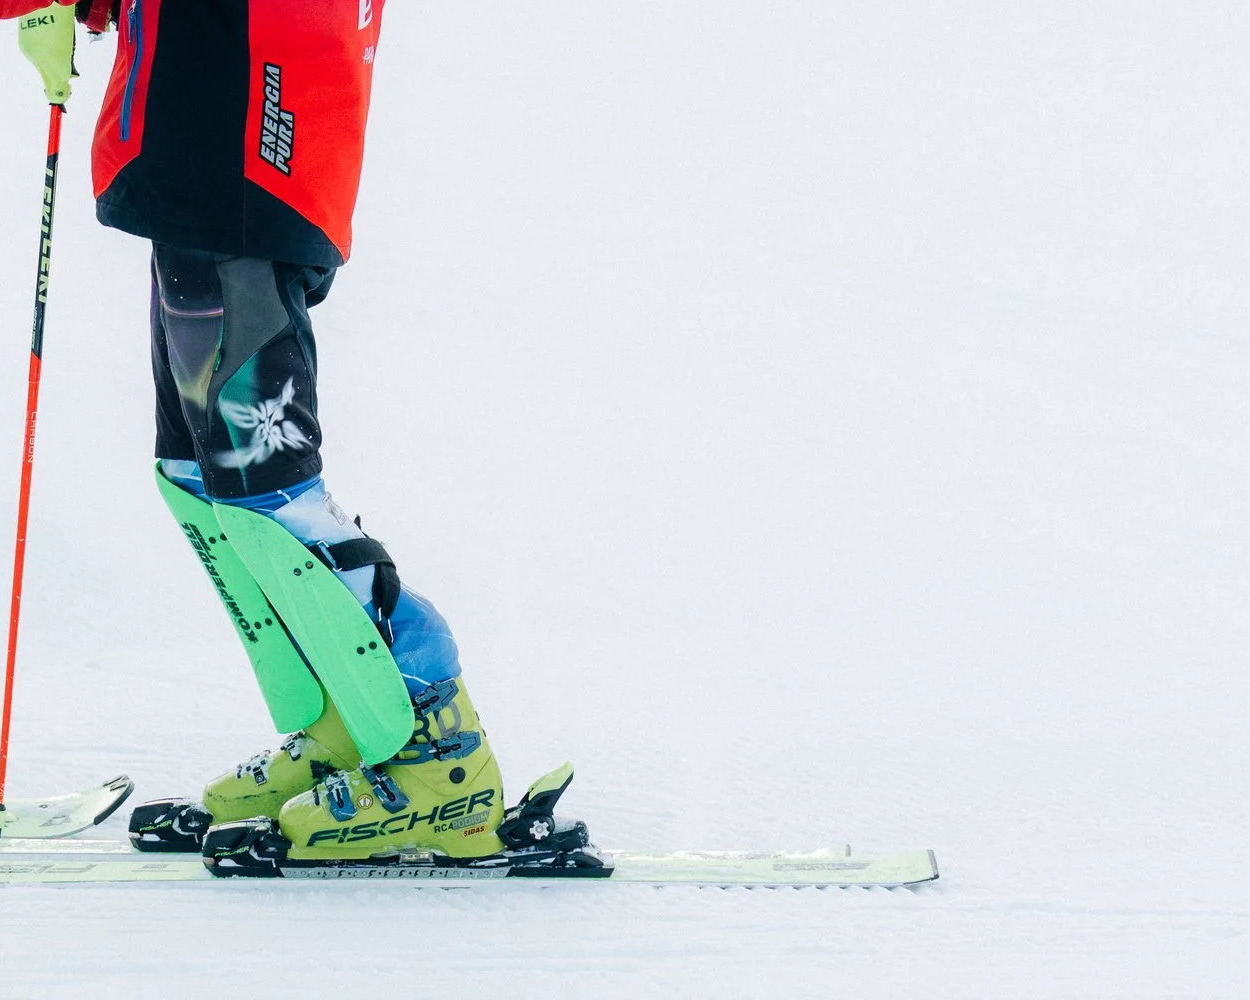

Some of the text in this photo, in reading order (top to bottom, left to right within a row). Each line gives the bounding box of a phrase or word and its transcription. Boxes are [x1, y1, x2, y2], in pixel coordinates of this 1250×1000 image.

[20, 14, 55, 30] LEKI
[260, 64, 280, 164] ENERGIA
[275, 111, 294, 175] PURA
[181, 522, 259, 644] KOMPERDELL
[139, 819, 173, 832] FISCHER
[307, 789, 495, 847] FISCHER
[463, 825, 485, 837] SIDAS
